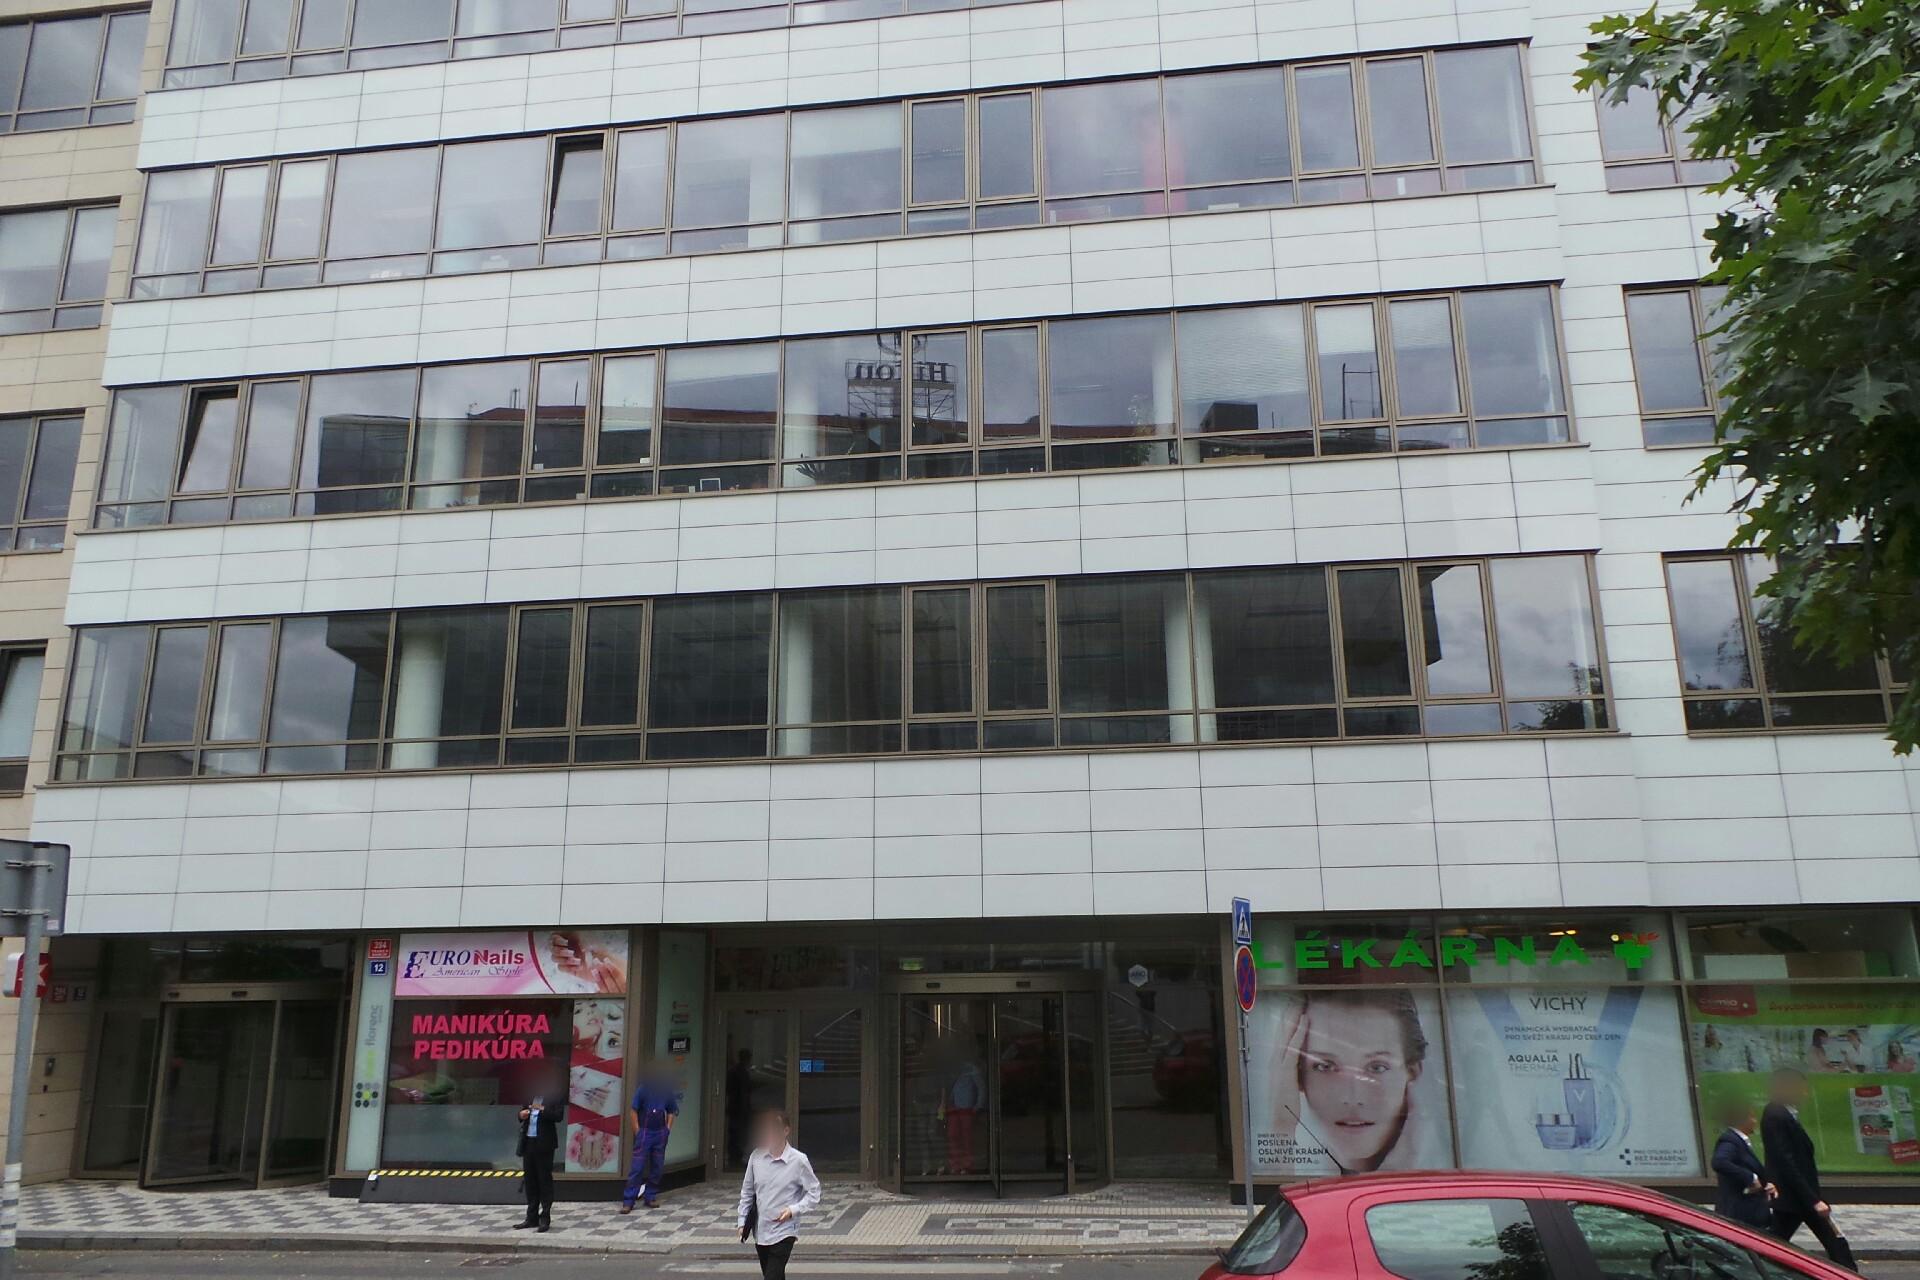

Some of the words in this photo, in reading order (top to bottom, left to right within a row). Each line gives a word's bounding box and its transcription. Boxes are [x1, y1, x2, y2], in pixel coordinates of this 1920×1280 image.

[1250, 930, 1592, 969] LÉKÁRNA
[374, 963, 384, 973] 12
[404, 949, 472, 979] EURO
[473, 948, 525, 965] Nails
[488, 965, 524, 978] Style
[1529, 997, 1587, 1010] VICHY
[412, 1009, 551, 1034] MANIKÚRA
[413, 1035, 545, 1060] PEDIKÚRA
[1510, 1063, 1560, 1071] THERMAL
